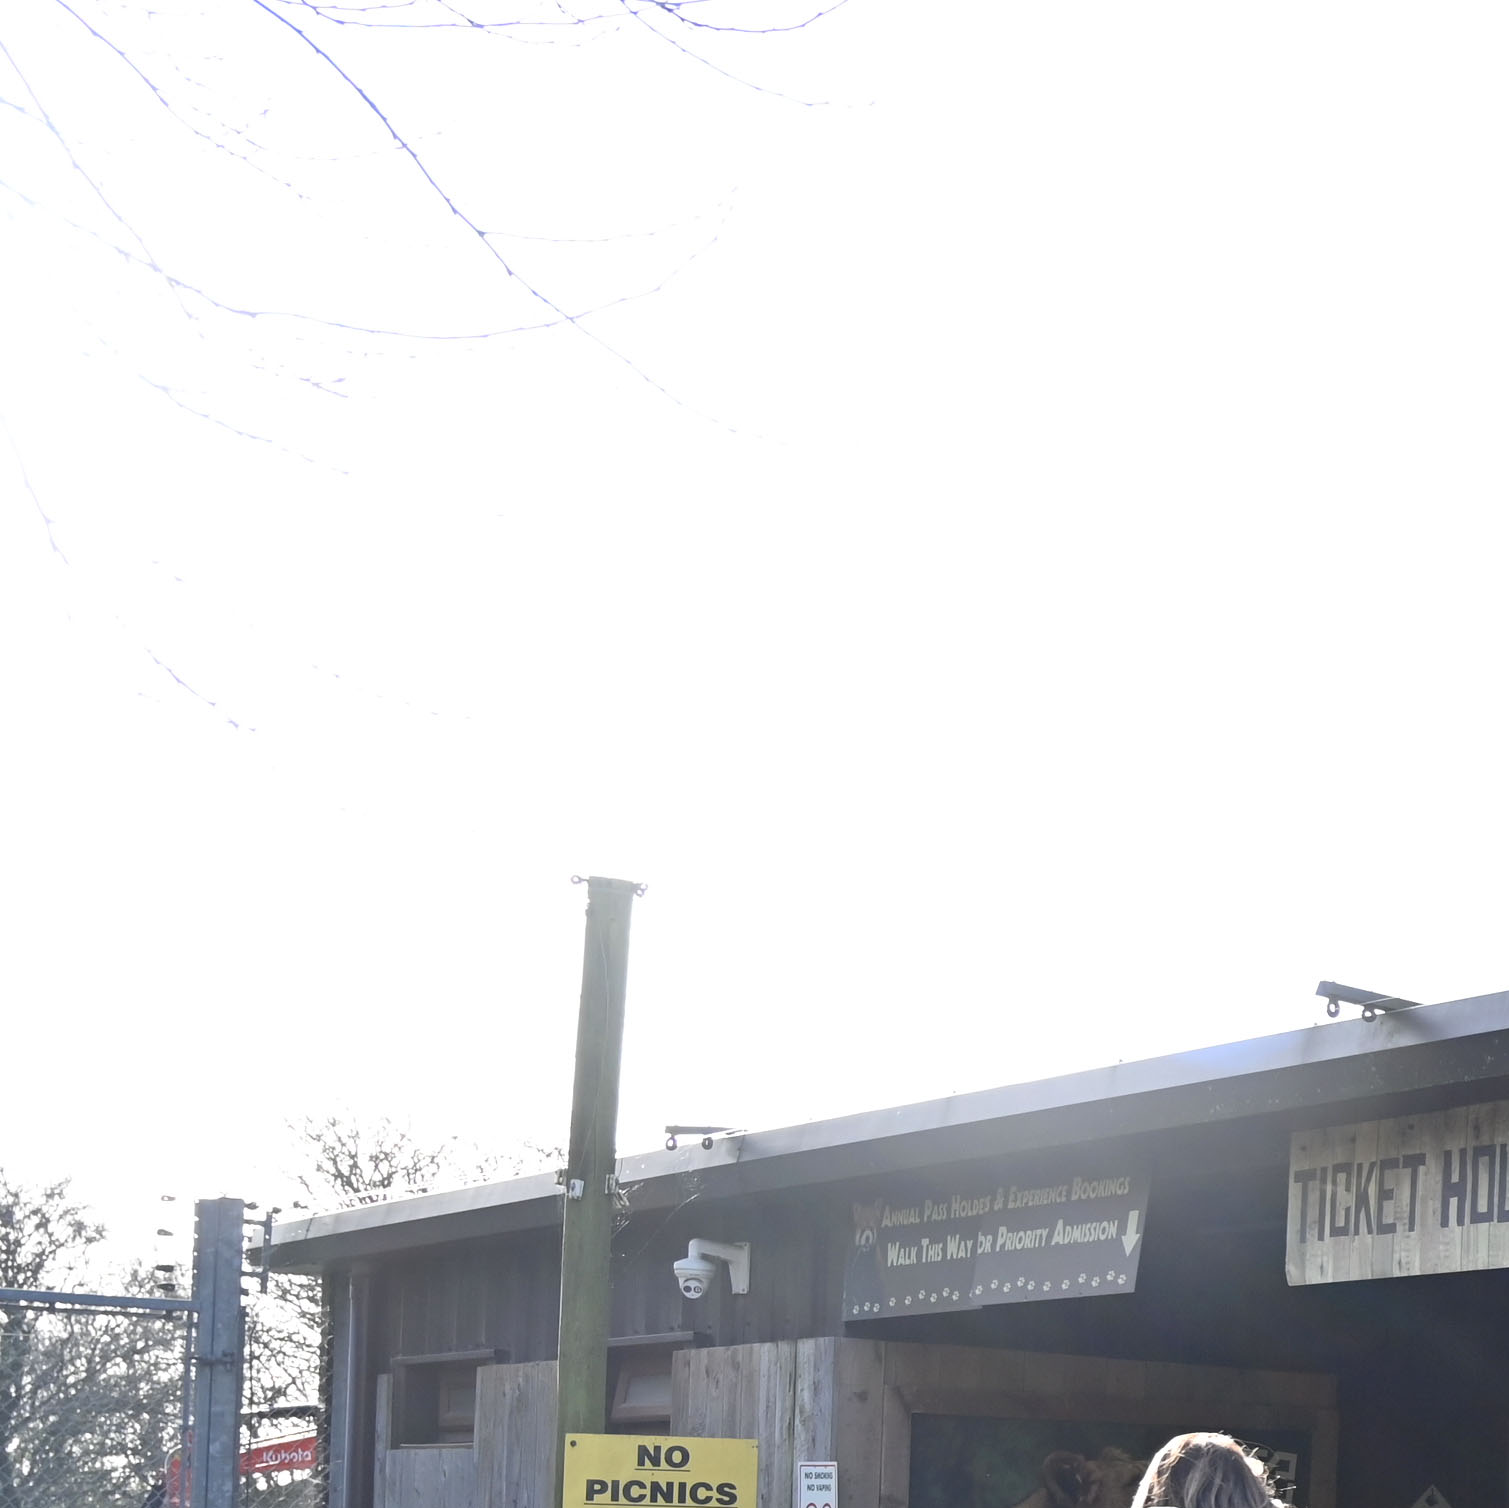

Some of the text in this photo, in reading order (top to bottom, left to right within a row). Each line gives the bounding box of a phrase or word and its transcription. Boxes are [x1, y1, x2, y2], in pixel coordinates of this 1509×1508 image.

[882, 1206, 920, 1227] ANNUAL
[924, 1200, 947, 1222] PASS
[1008, 1185, 1067, 1208] EXPERIENCE
[1071, 1176, 1130, 1200] BOOKINGS
[1294, 1153, 1426, 1243] TICKET
[887, 1242, 917, 1267] WALK
[921, 1238, 942, 1262] THIS
[947, 1235, 972, 1259] WAY
[996, 1226, 1049, 1251] PRIORITY
[1051, 1219, 1118, 1245] ADMISSION
[637, 1445, 690, 1468] NO
[586, 1479, 737, 1505] PICNICS
